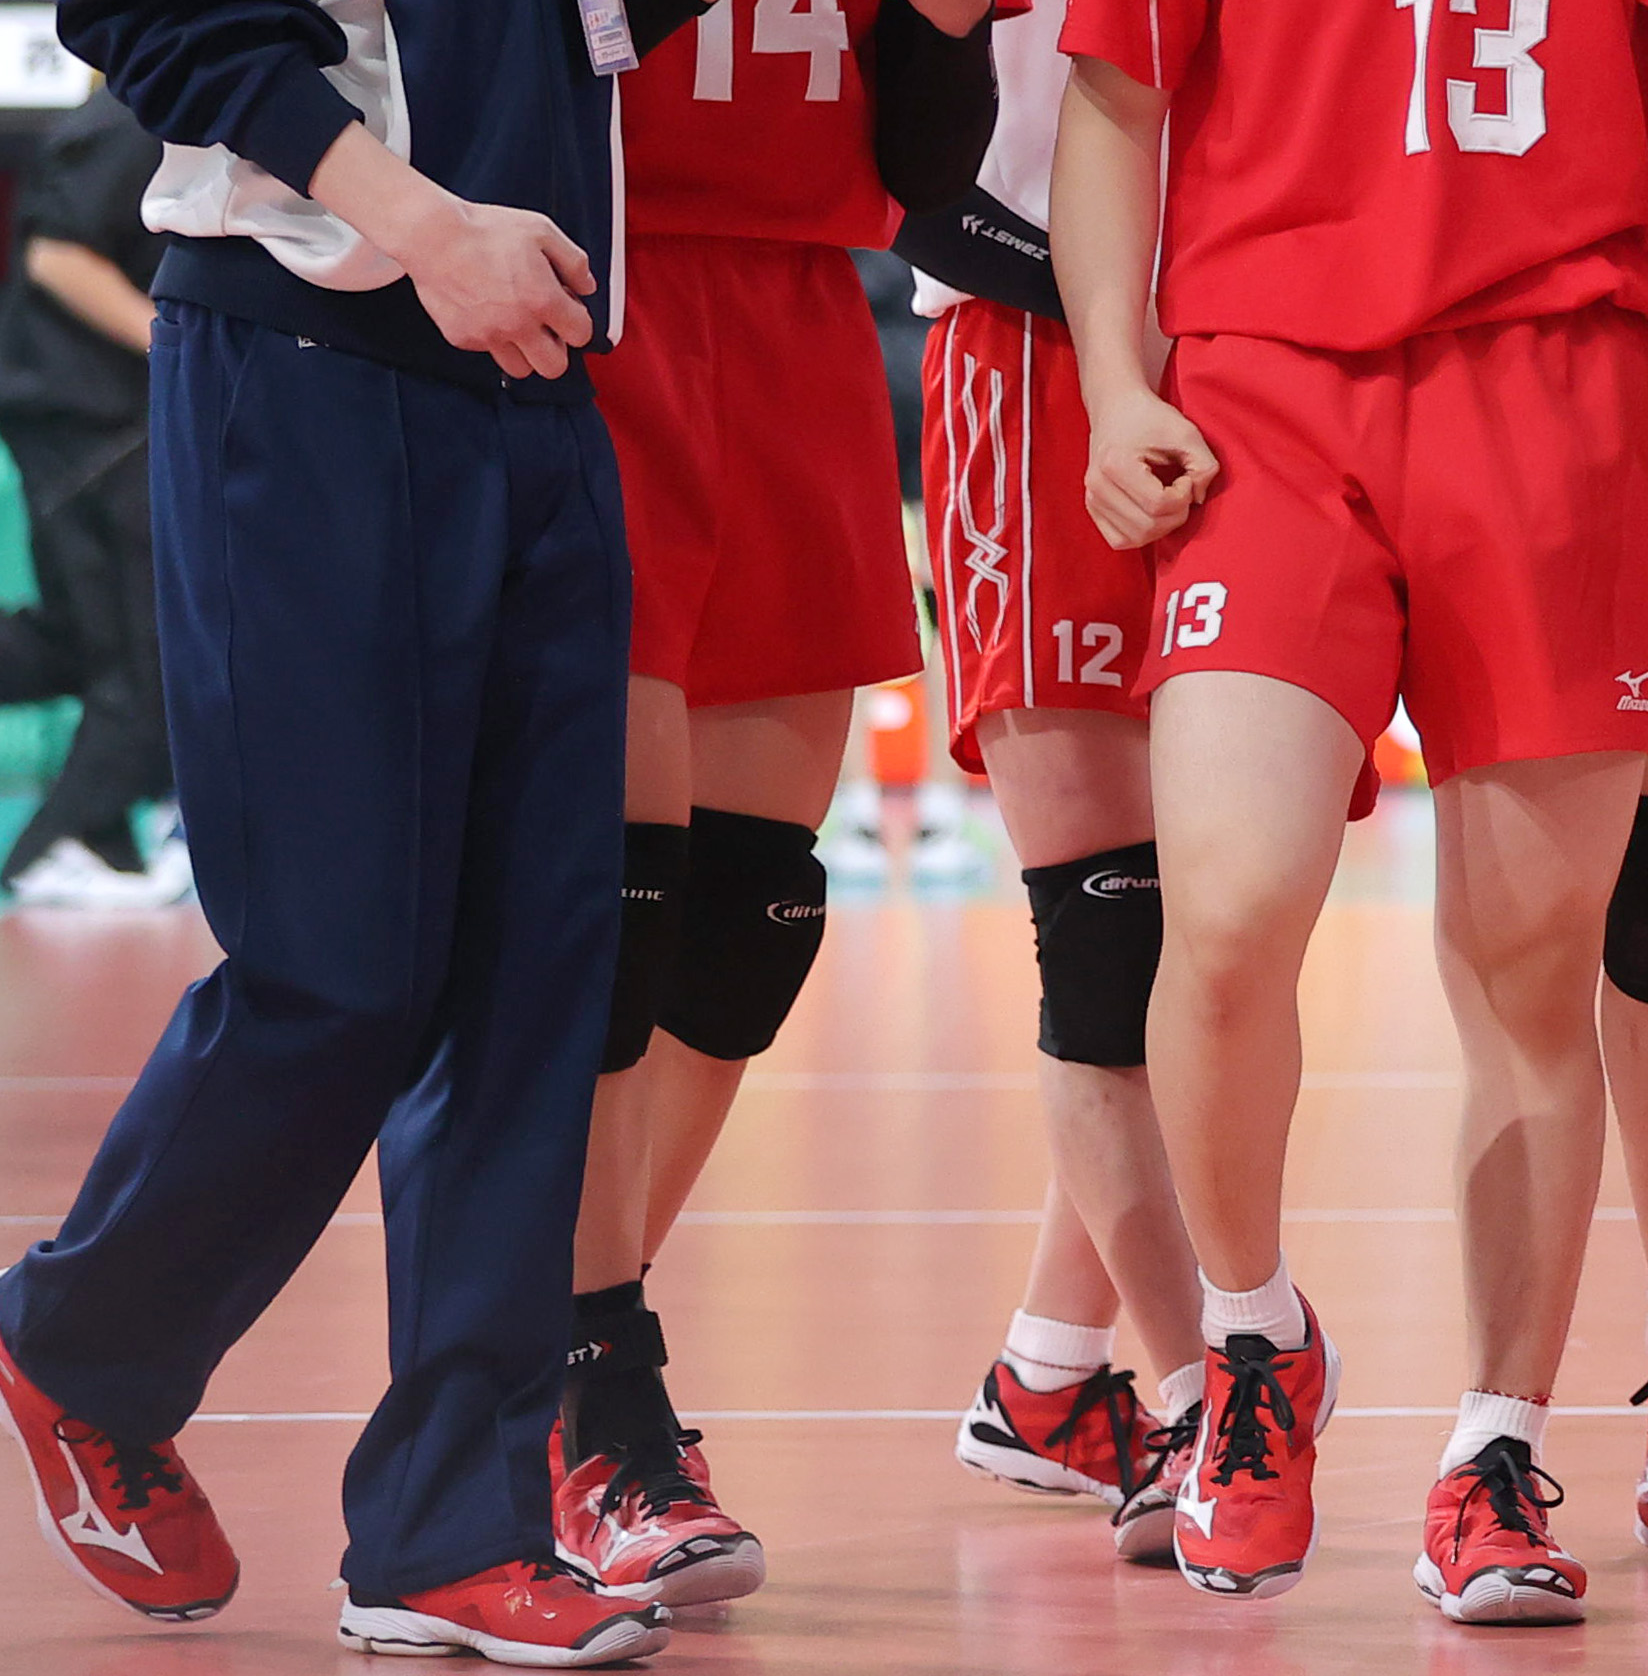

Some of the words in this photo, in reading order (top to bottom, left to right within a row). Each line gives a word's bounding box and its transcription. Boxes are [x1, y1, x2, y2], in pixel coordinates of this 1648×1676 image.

[1052, 618, 1123, 688] 12
[1160, 580, 1229, 657] 13
[1100, 874, 1160, 891] difun
